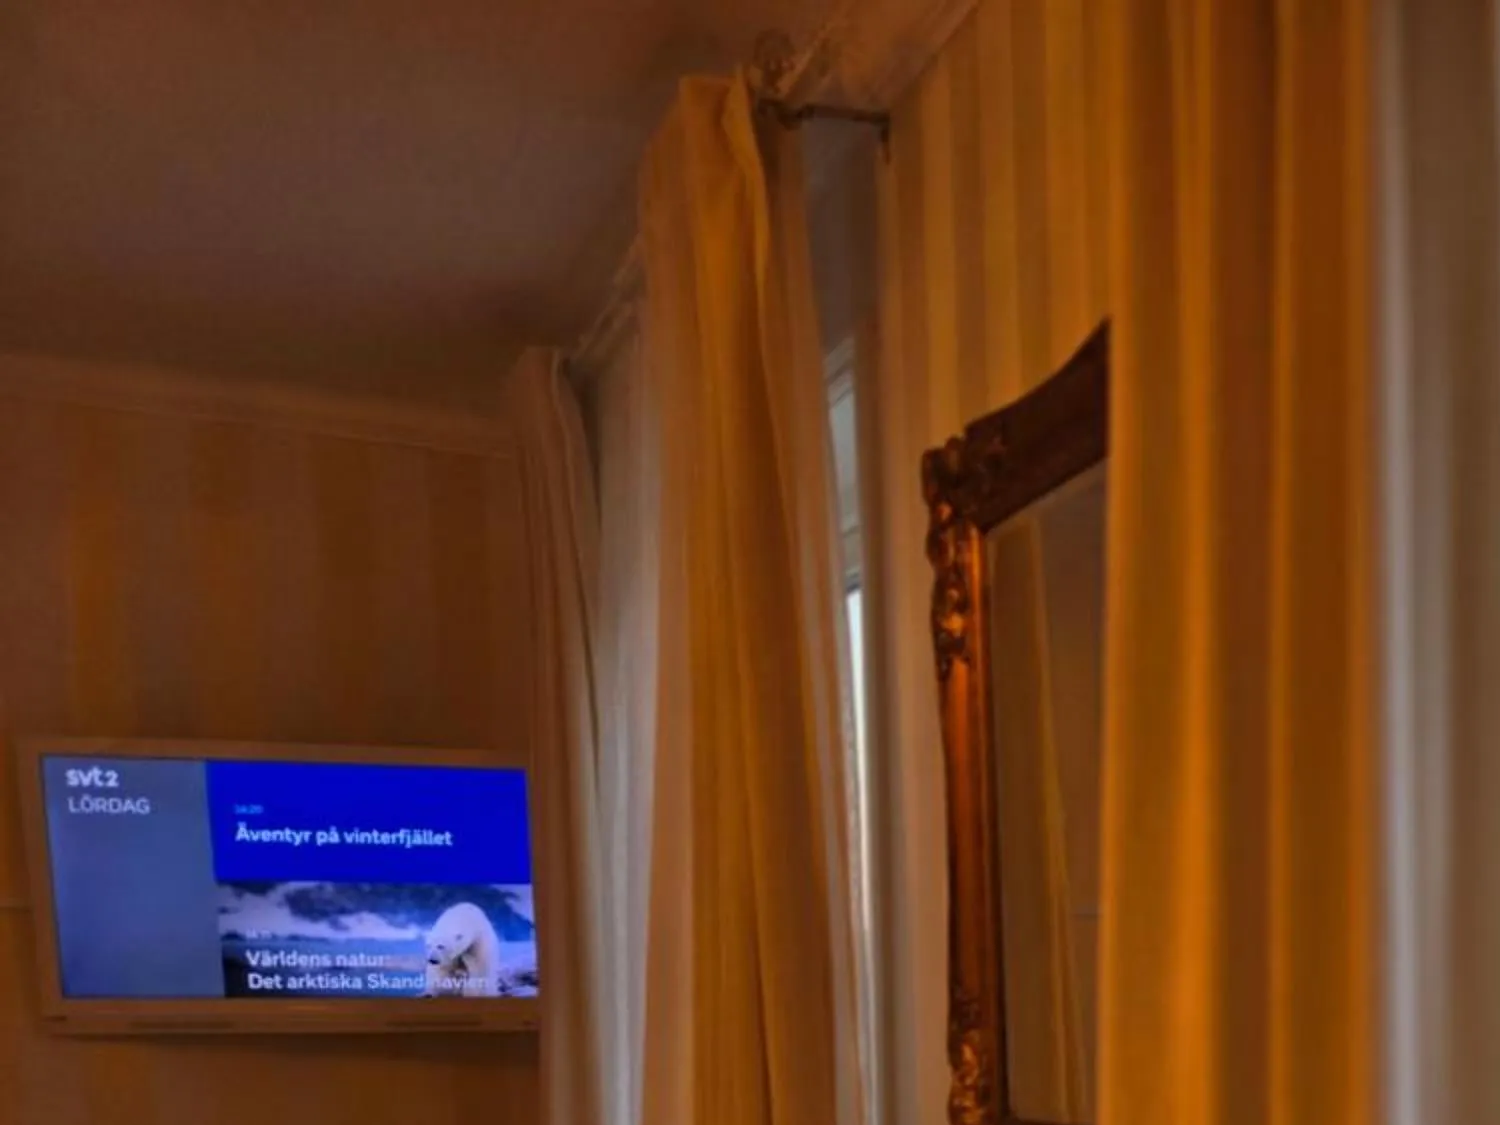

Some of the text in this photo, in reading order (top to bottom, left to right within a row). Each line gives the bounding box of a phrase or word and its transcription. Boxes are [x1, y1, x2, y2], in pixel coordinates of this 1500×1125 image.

[67, 793, 151, 815] LÖRDAG
[236, 821, 453, 849] Äventyr på vinterfjället
[246, 950, 331, 968] Världens
[248, 973, 283, 990] Det
[287, 974, 362, 991] arktiska
